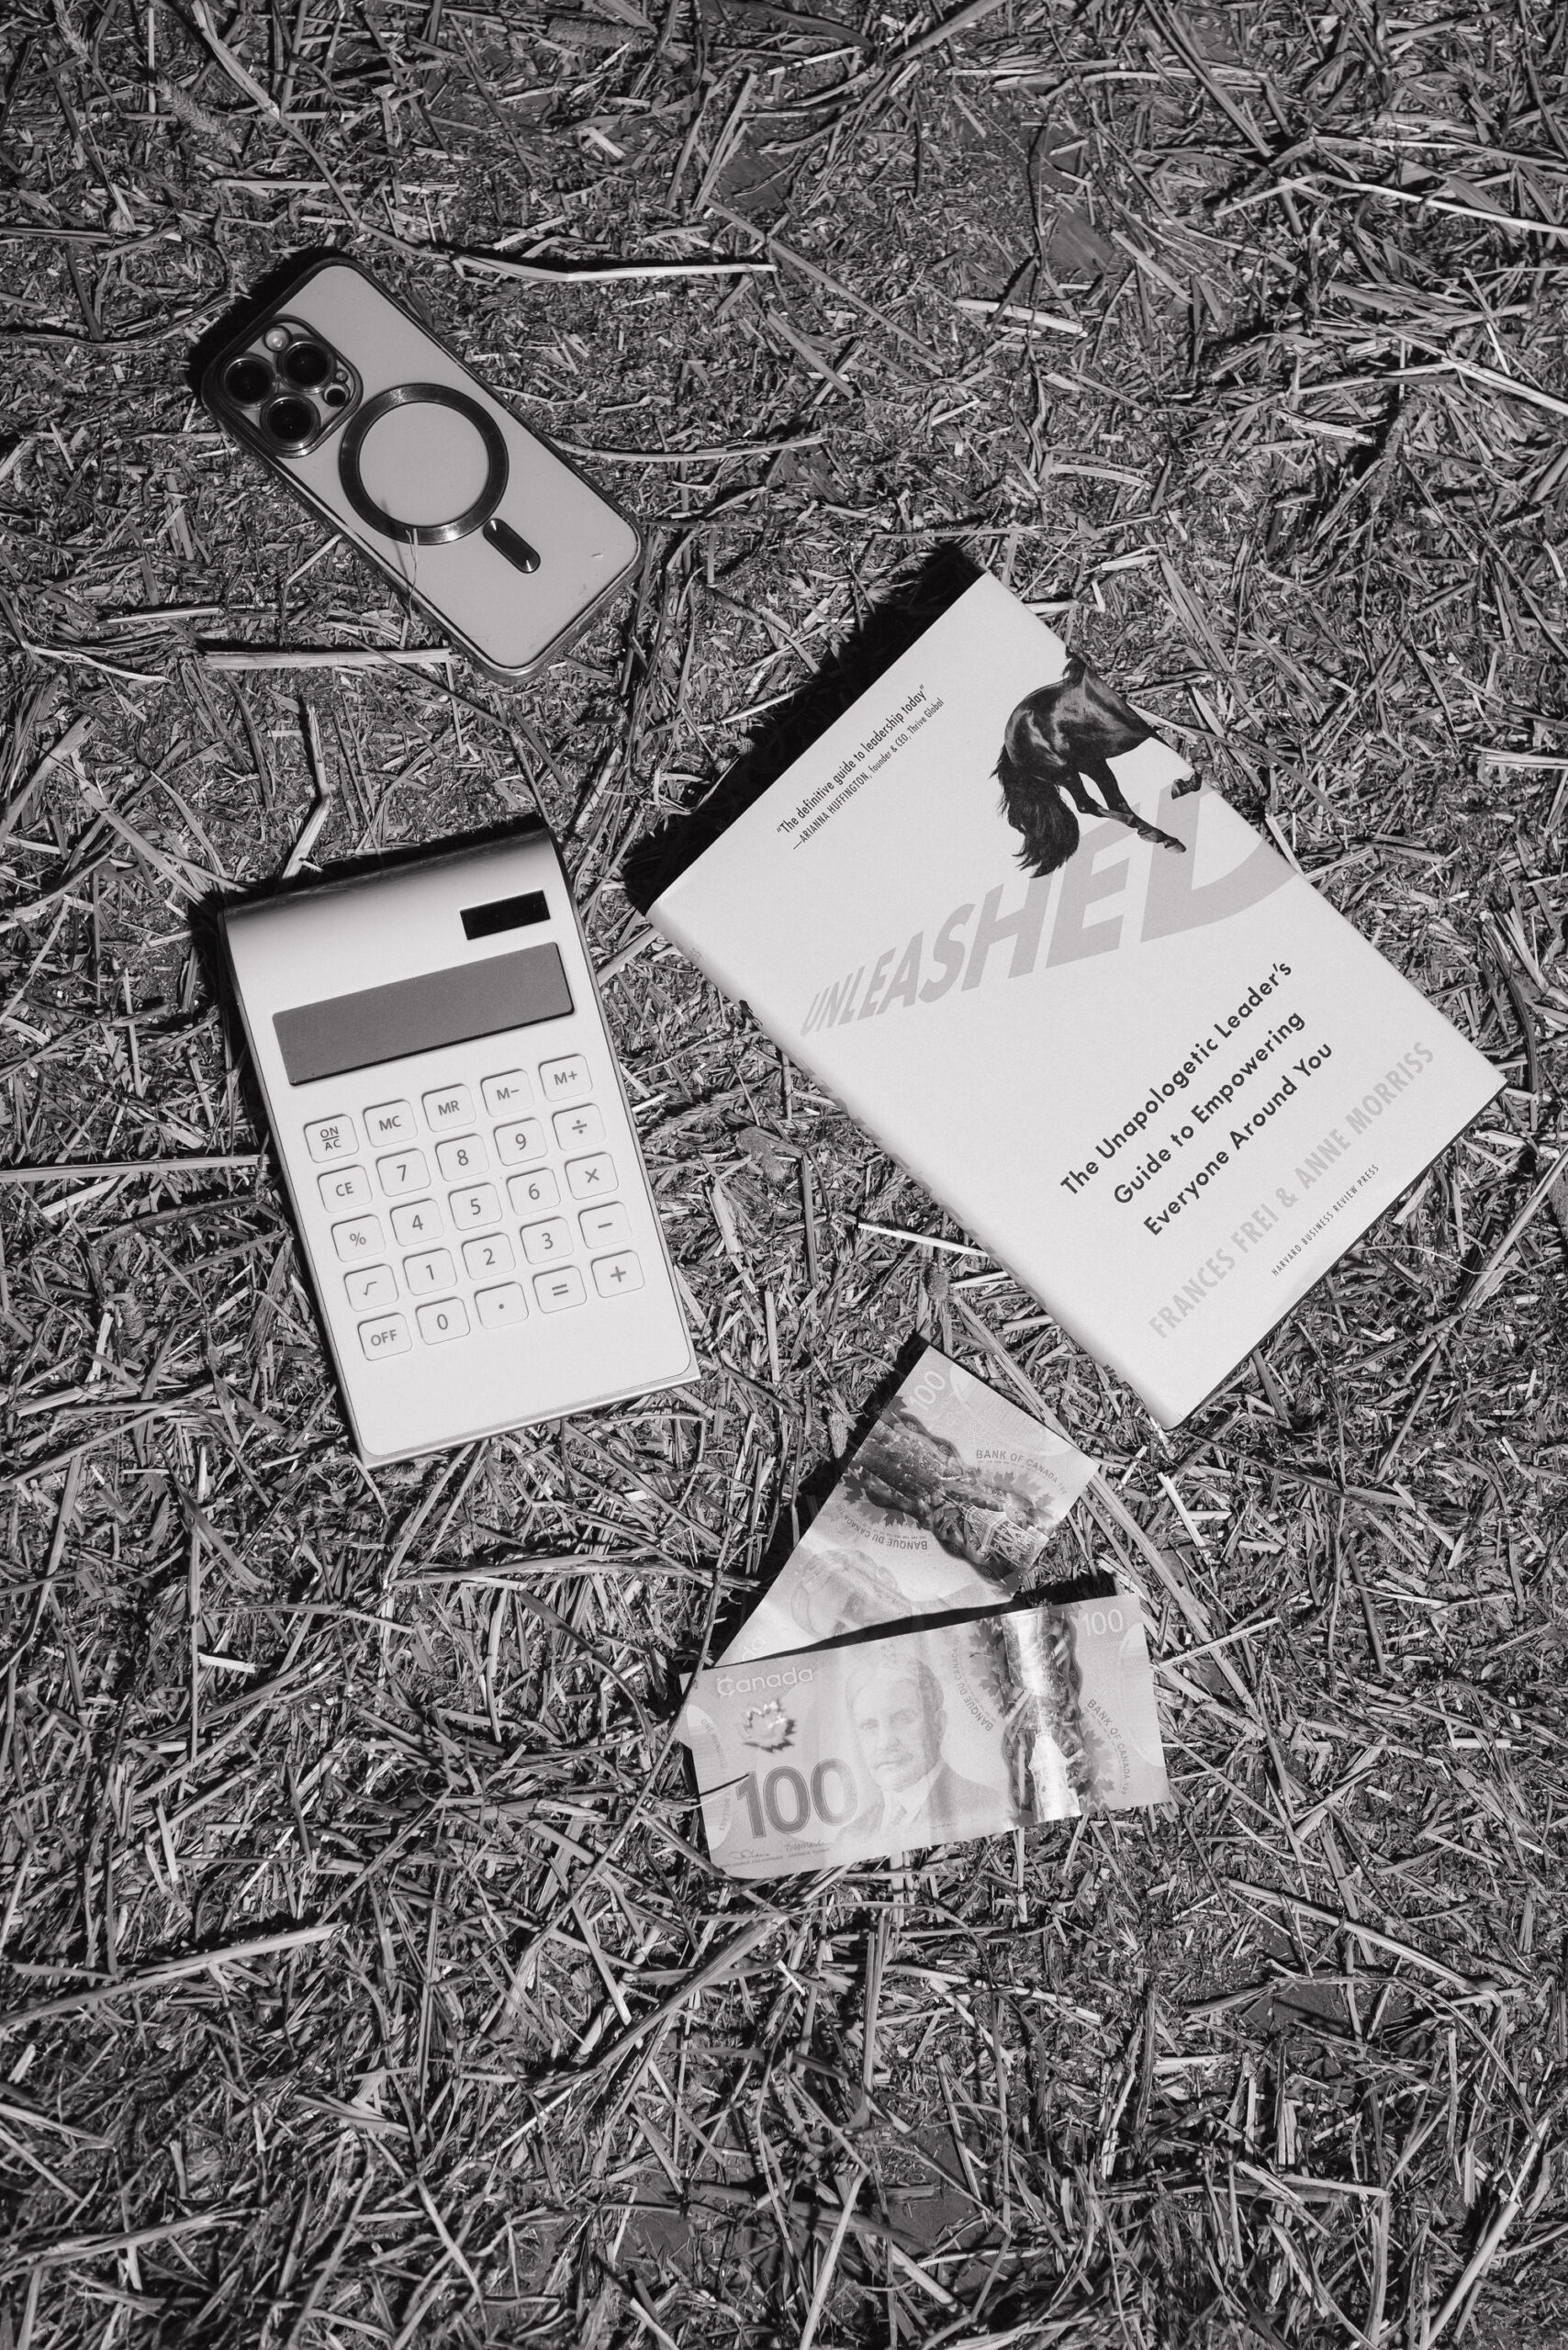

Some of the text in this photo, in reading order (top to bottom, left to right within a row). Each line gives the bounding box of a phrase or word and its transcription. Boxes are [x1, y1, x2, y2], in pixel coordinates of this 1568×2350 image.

[828, 772, 873, 813] HUFFINGTON,
[868, 749, 893, 773] founder
[890, 744, 898, 753] &
[894, 733, 912, 747] CEO,
[907, 716, 927, 734] Thrive
[924, 698, 944, 718] Global
[796, 781, 835, 819] definitive
[833, 759, 857, 785] guide
[854, 753, 865, 762] to
[860, 711, 905, 754] leadership
[800, 773, 1299, 1035] UNLEASHED
[554, 1070, 578, 1086] M+
[437, 1101, 461, 1116] MR
[1060, 1158, 1100, 1195] The
[1094, 1037, 1219, 1160] Unapologetic
[1114, 1012, 1305, 1203] Guide to Empowering
[319, 1125, 340, 1139] ON
[379, 1115, 402, 1132] MC
[324, 1139, 342, 1151] AC
[515, 1133, 527, 1150] 9
[1142, 1043, 1333, 1237] Everyone Around You
[457, 1149, 469, 1167] 8
[397, 1164, 408, 1182] 7
[335, 1181, 354, 1197] CE
[529, 1182, 540, 1201] 6
[1148, 1042, 1434, 1338] FRANCES FREI & ANNE MORRISS
[470, 1199, 481, 1215] 5
[411, 1214, 423, 1232] 4
[1271, 1164, 1379, 1276] HARVARD BUSINESS REVIEW PRESS
[542, 1232, 554, 1250] 3
[483, 1248, 496, 1266] 2
[425, 1263, 435, 1281] 1
[437, 1314, 449, 1331] 0
[371, 1329, 397, 1347] OFF
[909, 1370, 946, 1413] 100
[976, 1450, 1006, 1460] BANK
[1010, 1453, 1025, 1462] OF
[1026, 1459, 1058, 1483] CANADA
[844, 1515, 871, 1538] CANADA
[872, 1535, 885, 1544] DU
[887, 1539, 927, 1550] BANQUE
[1081, 1609, 1124, 1637] 100
[717, 1667, 815, 1696] Canada
[958, 1683, 968, 1695] DU
[964, 1695, 993, 1731] BANQUE
[1087, 1698, 1113, 1726] BANK
[1110, 1728, 1122, 1740] OF
[1117, 1743, 1129, 1779] CANADA
[735, 1758, 857, 1839] 100
